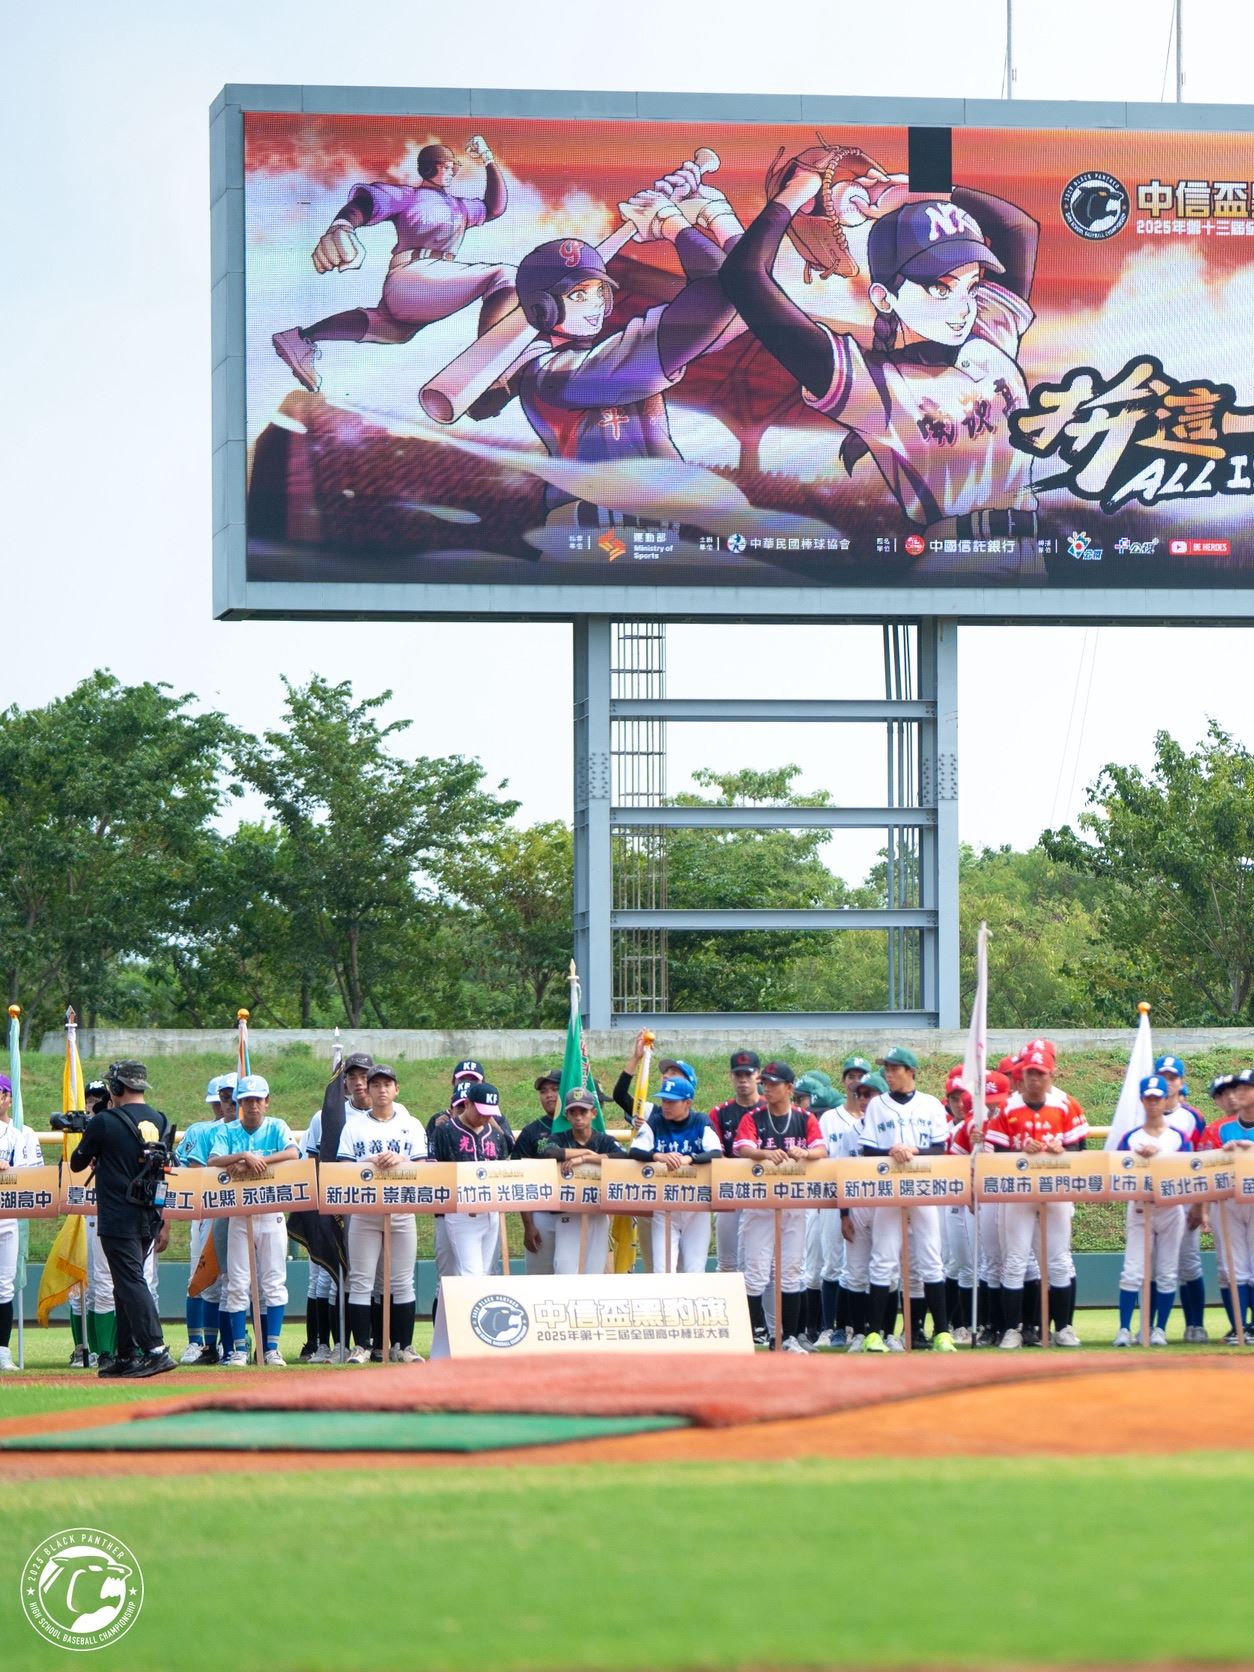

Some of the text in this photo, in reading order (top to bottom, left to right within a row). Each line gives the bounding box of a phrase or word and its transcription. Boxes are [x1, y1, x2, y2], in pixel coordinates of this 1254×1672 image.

[1111, 456, 1215, 504] ALL
[633, 544, 674, 553] Ministry of
[750, 537, 851, 550] 中華民國棒球協會
[929, 539, 1017, 553] 中國信託銀行
[633, 552, 660, 560] Sports
[242, 1182, 311, 1206] 永靖高工
[496, 1183, 554, 1202] 光復高中
[607, 1183, 712, 1203] 新竹市 新竹高
[718, 1181, 838, 1199] 高雄市 中正預校
[844, 1178, 964, 1198] 新竹縣 陽交附中
[983, 1175, 1104, 1194] 高雄市 普門中學
[1160, 1175, 1209, 1197] 新北市
[1214, 1172, 1235, 1190] 新
[326, 1186, 451, 1205] 新北市 崇義高中
[582, 1185, 601, 1204] 成
[533, 1297, 731, 1329] 中信盃黑豹旗
[536, 1328, 731, 1342] 2025年第十三屆全國高中棒球大賽
